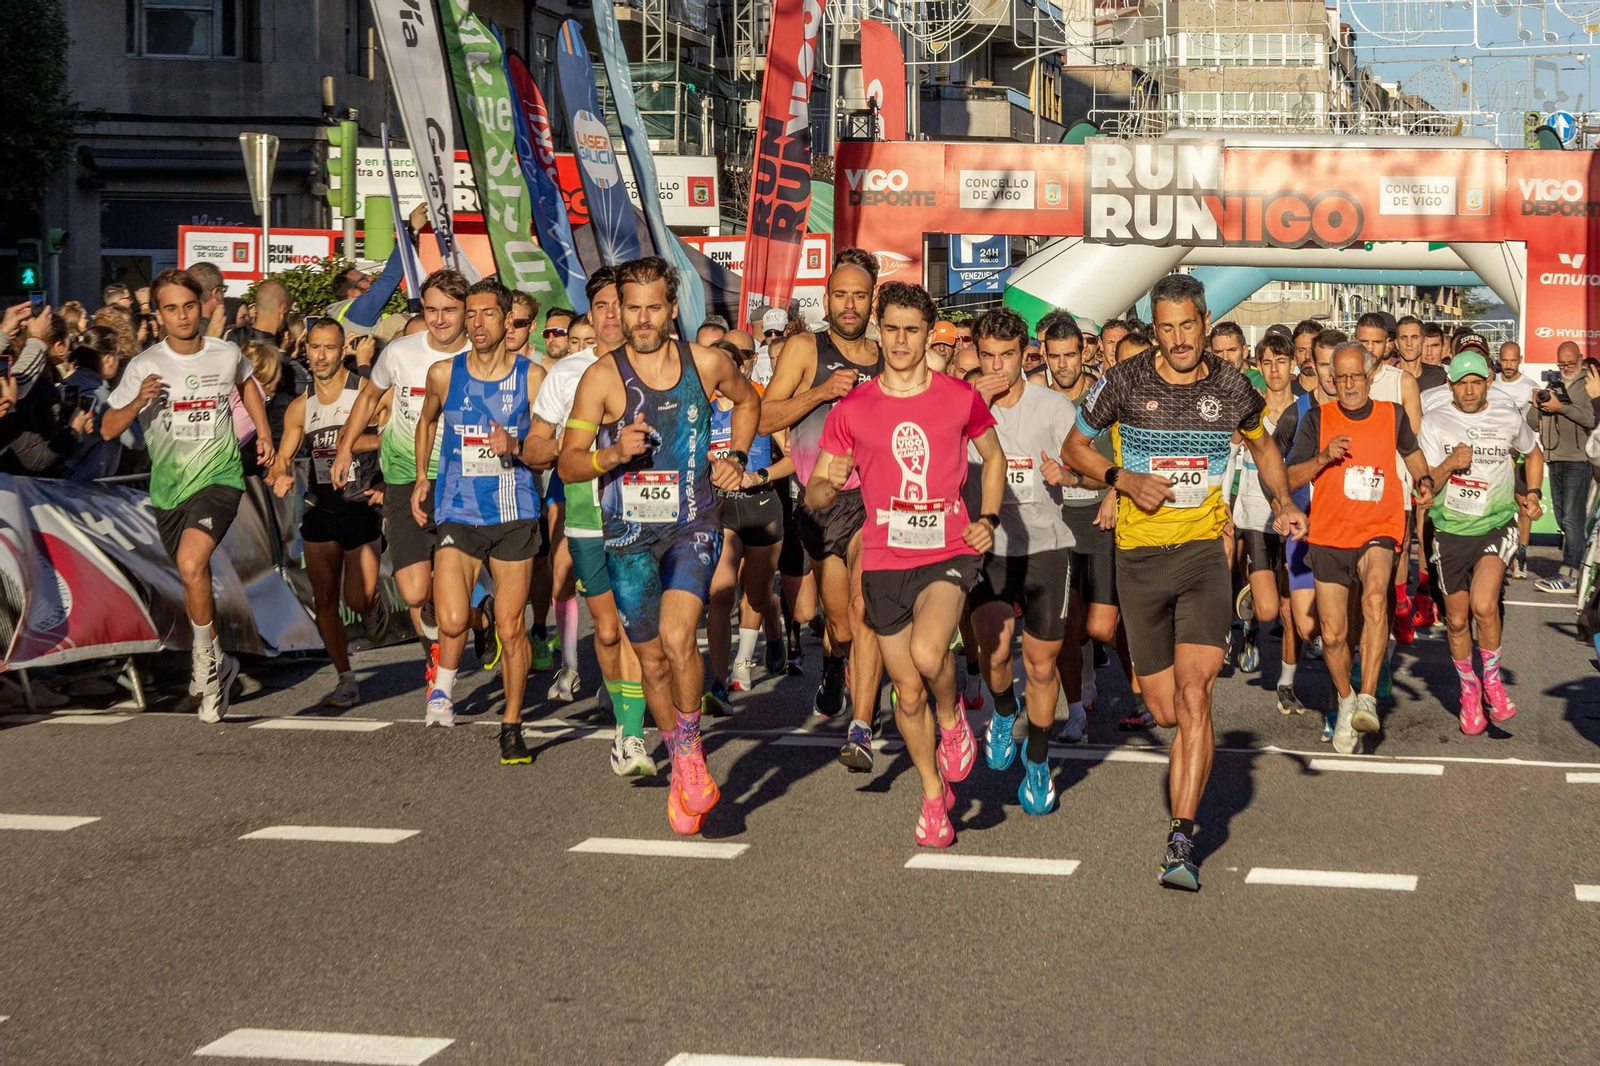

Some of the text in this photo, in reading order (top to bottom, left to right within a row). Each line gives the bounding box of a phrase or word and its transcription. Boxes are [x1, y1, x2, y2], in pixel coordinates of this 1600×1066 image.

[576, 131, 612, 150] LASER
[365, 158, 379, 166] en
[1090, 145, 1219, 190] RUN
[845, 169, 909, 191] VIGO
[965, 178, 1029, 190] CONCELLO
[972, 190, 1021, 200] DE VIGO
[1385, 184, 1450, 196] CONCELLO
[1518, 178, 1584, 202] VIGO
[849, 190, 936, 206] DEPORTE
[1392, 196, 1443, 207] DE VIGO
[1522, 200, 1600, 217] DEPORT
[193, 244, 229, 252] CONCELLO
[269, 245, 293, 253] RUN
[980, 248, 998, 257] 24H
[711, 251, 732, 261] RUN
[960, 272, 1000, 280] VENEZUELA
[1540, 272, 1600, 286] amura
[1556, 328, 1600, 338] HYUNDA
[188, 411, 211, 423] 658
[1170, 472, 1202, 485] 640
[640, 487, 671, 500] 456
[1459, 488, 1481, 500] 399
[907, 515, 938, 528] 452
